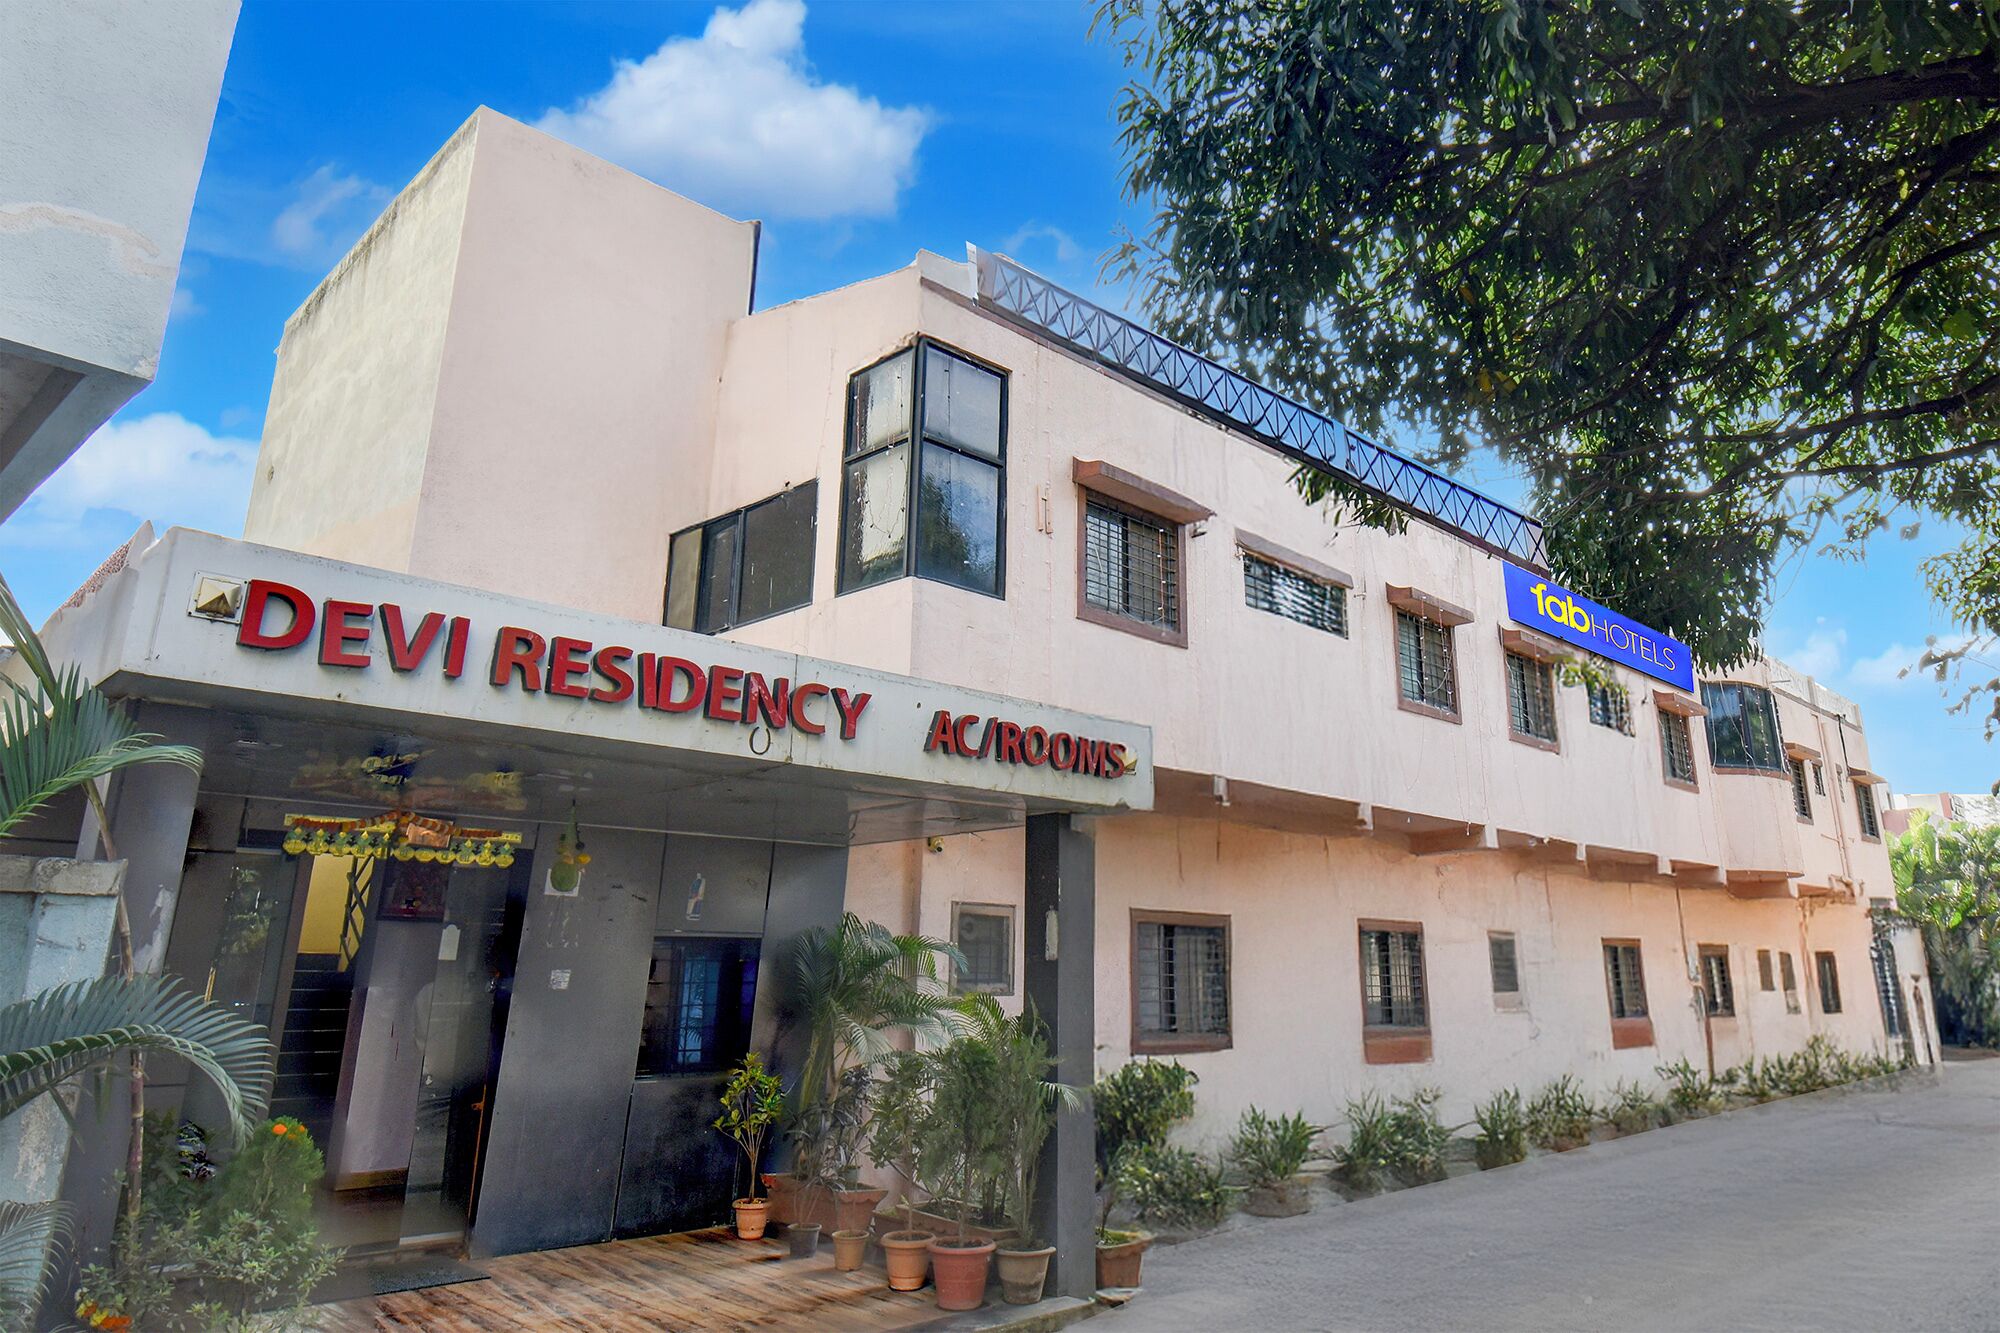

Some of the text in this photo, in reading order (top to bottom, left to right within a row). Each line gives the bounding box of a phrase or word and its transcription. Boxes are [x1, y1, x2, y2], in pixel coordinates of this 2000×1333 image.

[236, 579, 872, 740] DEVI RESIDENCY
[1530, 583, 1676, 671] fabHOTELS
[924, 709, 1128, 778] AC/ROOMS
